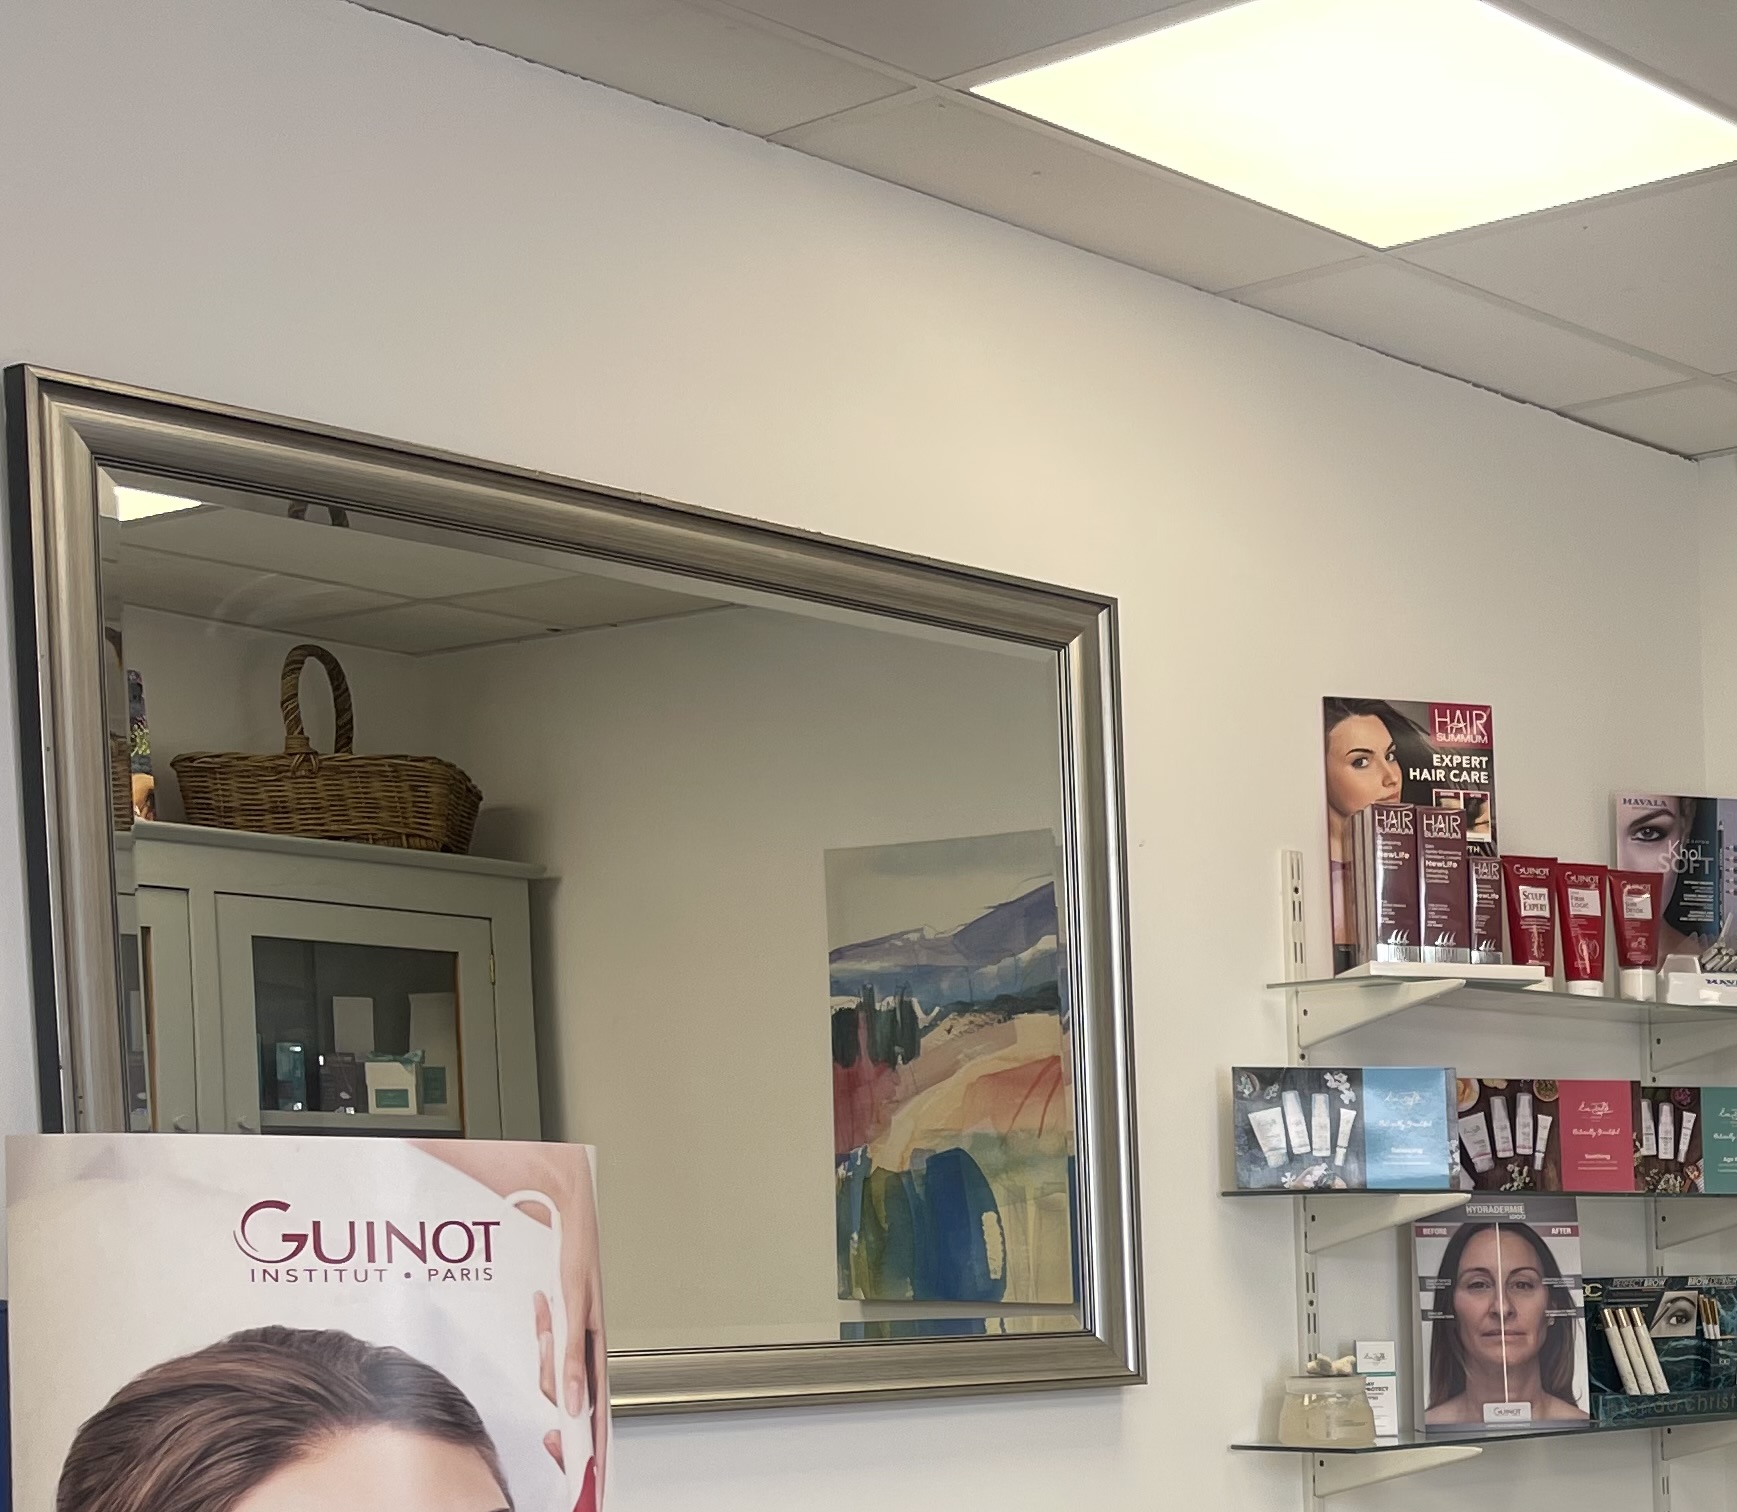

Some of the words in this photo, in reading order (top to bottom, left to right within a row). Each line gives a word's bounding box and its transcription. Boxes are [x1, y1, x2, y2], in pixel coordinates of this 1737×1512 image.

[1434, 708, 1488, 736] HAIR
[1436, 733, 1488, 744] SUMMUM
[1432, 753, 1489, 769] EXPERT
[1409, 767, 1446, 782] HAIR
[1449, 769, 1489, 784] CARE
[1622, 797, 1667, 807] MAVALA
[1375, 809, 1413, 831] HAIR
[1423, 813, 1461, 835] HAIR
[1668, 839, 1702, 860] Khol
[1473, 862, 1500, 878] HAIR
[1513, 864, 1550, 876] GUINOT
[1658, 853, 1714, 874] SOFT
[1522, 891, 1547, 901] SCULPT
[1523, 902, 1547, 912] EXPERT
[233, 1199, 500, 1264] GUINOT
[1422, 1227, 1448, 1235] BEFORE
[1551, 1227, 1572, 1235] AFTER
[251, 1268, 386, 1283] INSTITUT
[427, 1266, 494, 1282] PARIS
